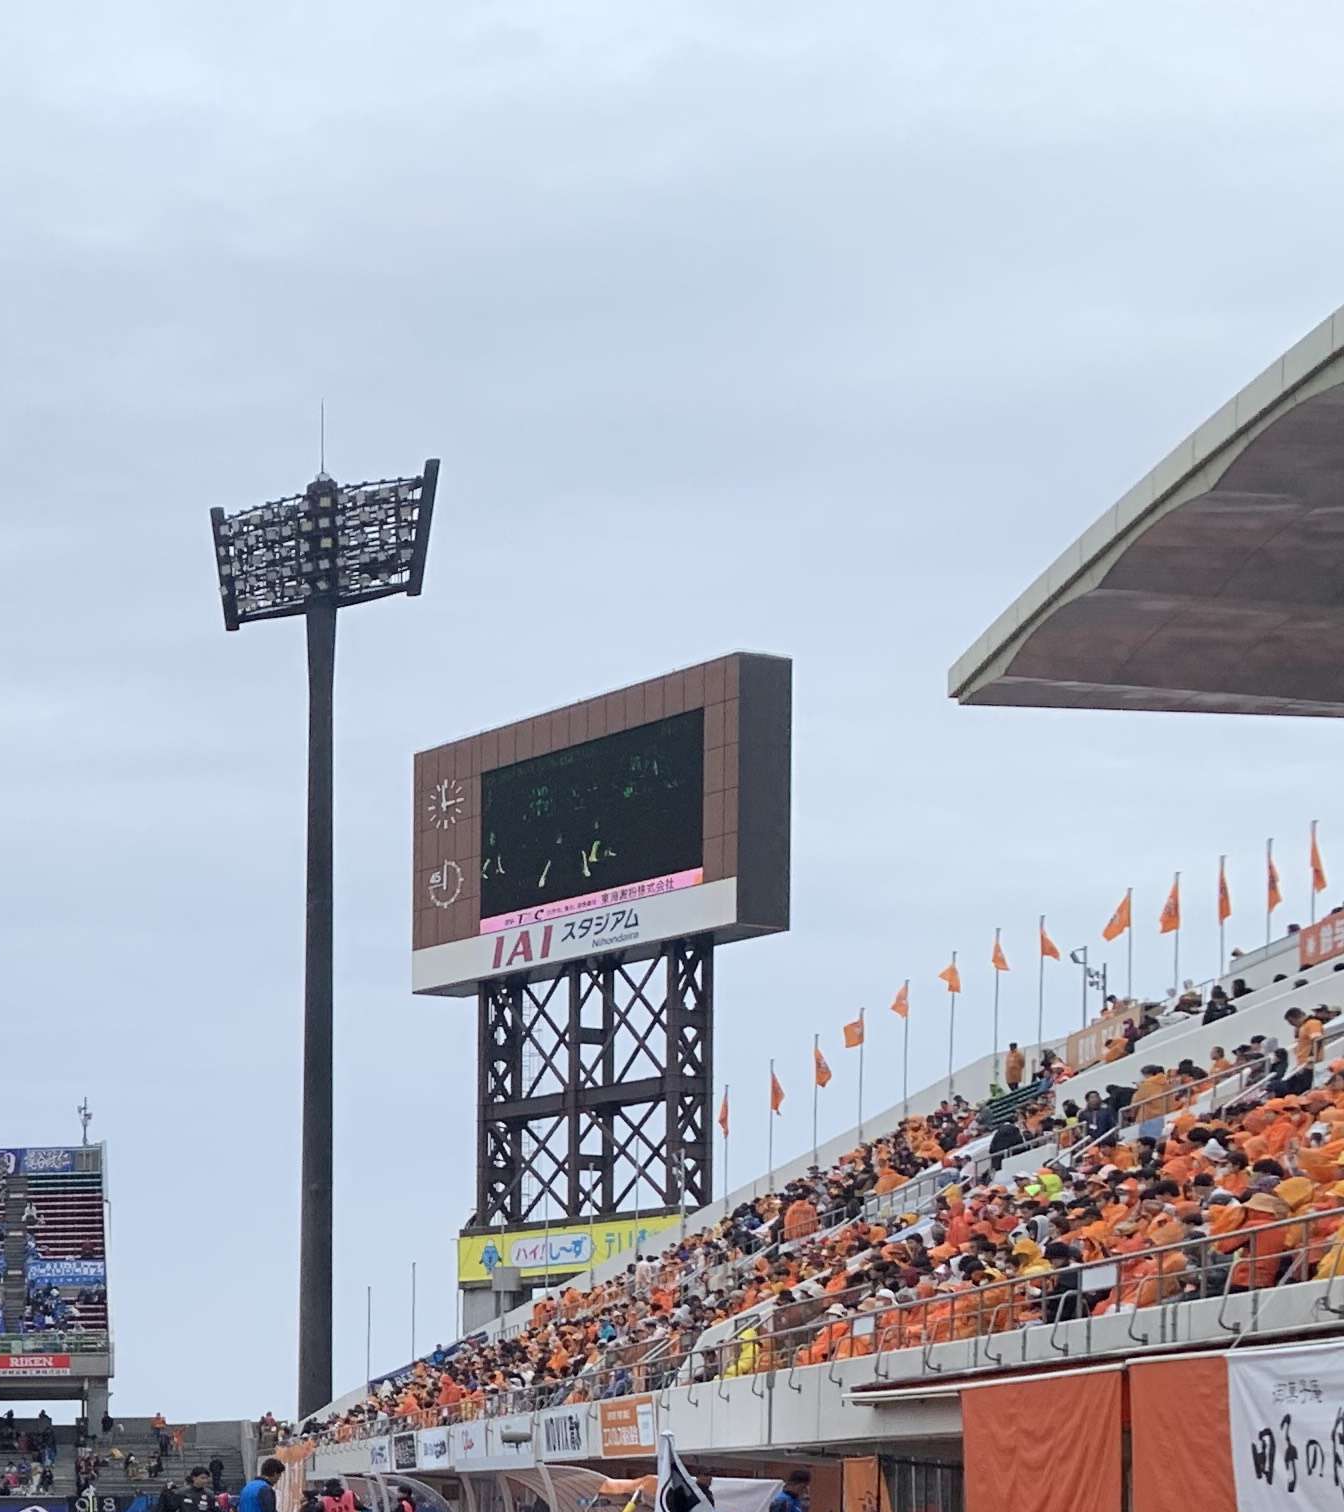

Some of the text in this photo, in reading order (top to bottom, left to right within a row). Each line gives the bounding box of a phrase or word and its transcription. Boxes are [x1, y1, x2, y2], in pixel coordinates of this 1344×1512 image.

[492, 924, 554, 970] IAI
[561, 907, 640, 943] スタジアム
[591, 931, 640, 949] Nihondaira
[9, 1356, 54, 1368] RIKEN
